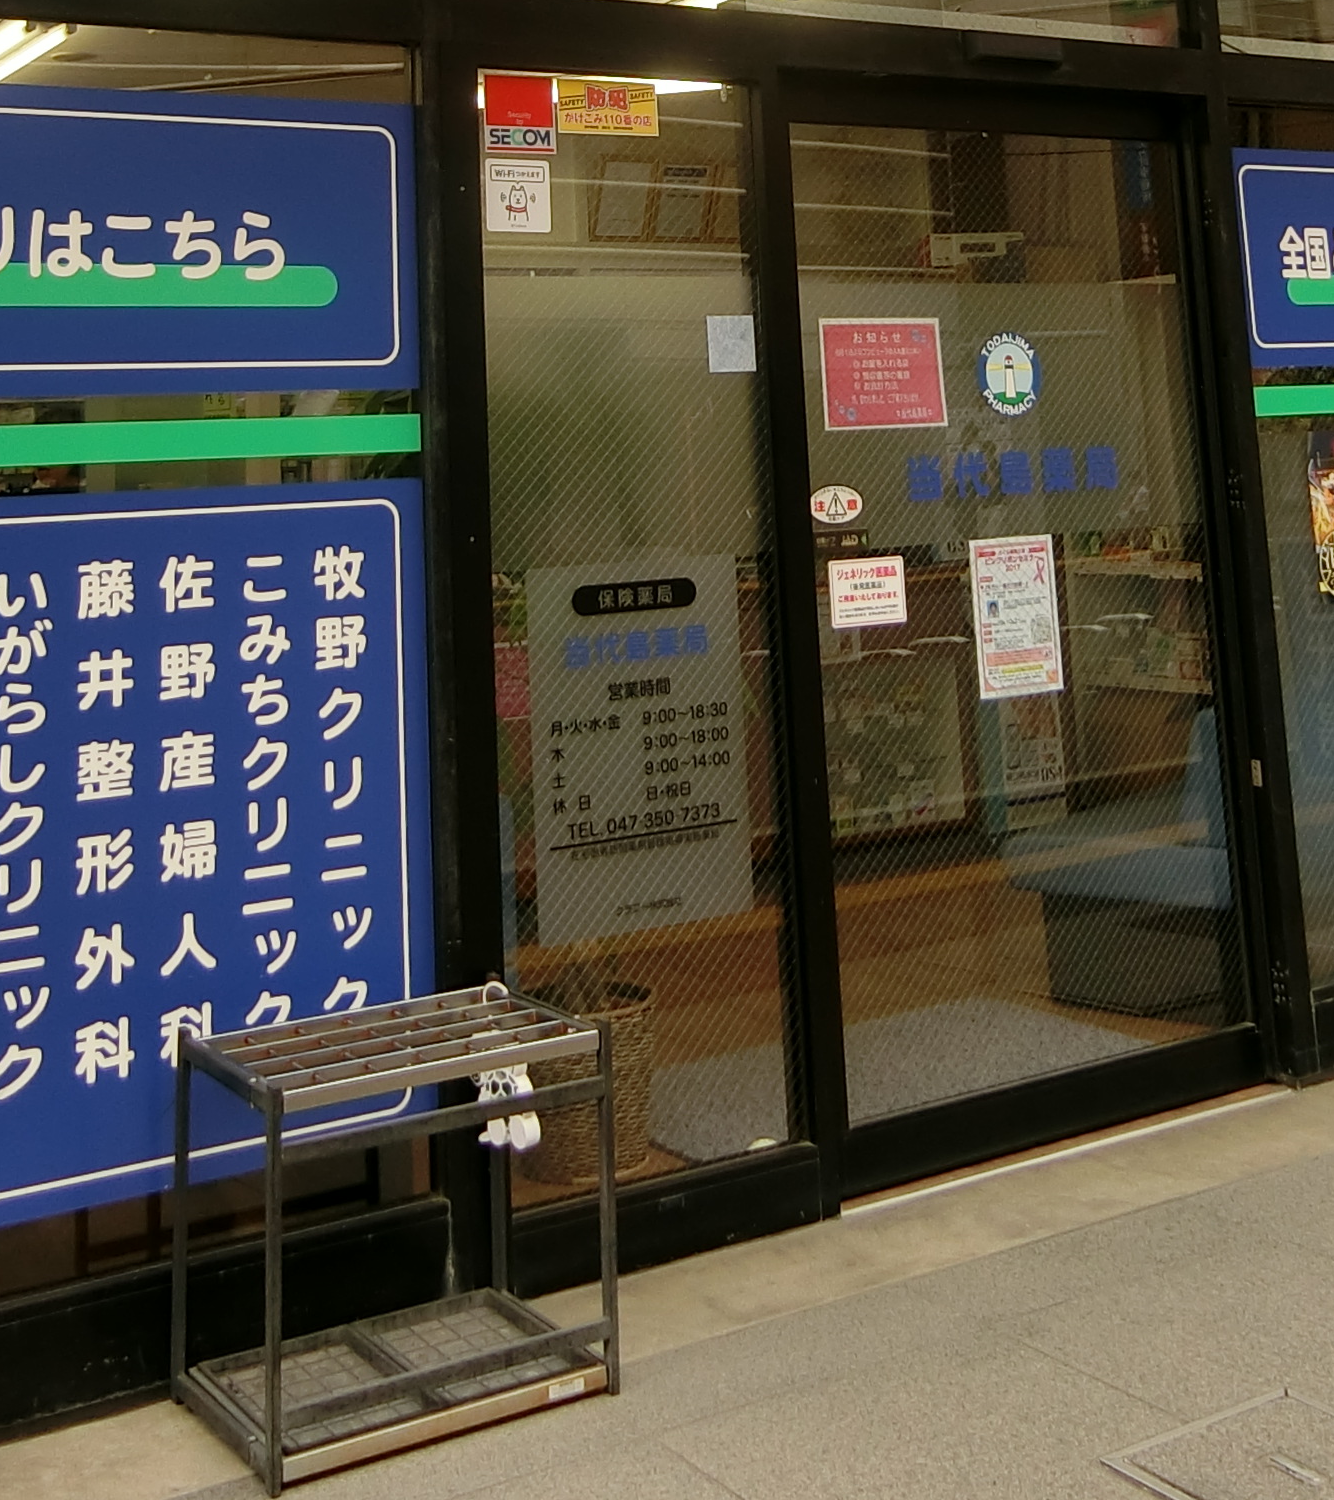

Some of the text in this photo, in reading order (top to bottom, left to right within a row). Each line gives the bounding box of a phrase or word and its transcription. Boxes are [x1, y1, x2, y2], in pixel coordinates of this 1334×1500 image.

[564, 113, 652, 128] かけこみ110番の店
[489, 128, 551, 147] SECOM
[852, 331, 902, 344] お知らせ
[980, 332, 1035, 360] TODAIJIMA
[982, 388, 1037, 416] PHARMACY
[906, 445, 1120, 502] 当代島薬局
[836, 565, 898, 581] ジェネリック医薬品
[597, 584, 673, 609] 保険薬局
[564, 624, 708, 670] 当代島薬局
[607, 677, 671, 701] 営業時間
[238, 554, 297, 1024] こみちクリニック
[312, 545, 373, 1012] 牧野クリニック
[552, 773, 567, 790] 土
[74, 558, 135, 1085] 藤井整形外科
[157, 553, 217, 1069] 佐野産婦人科
